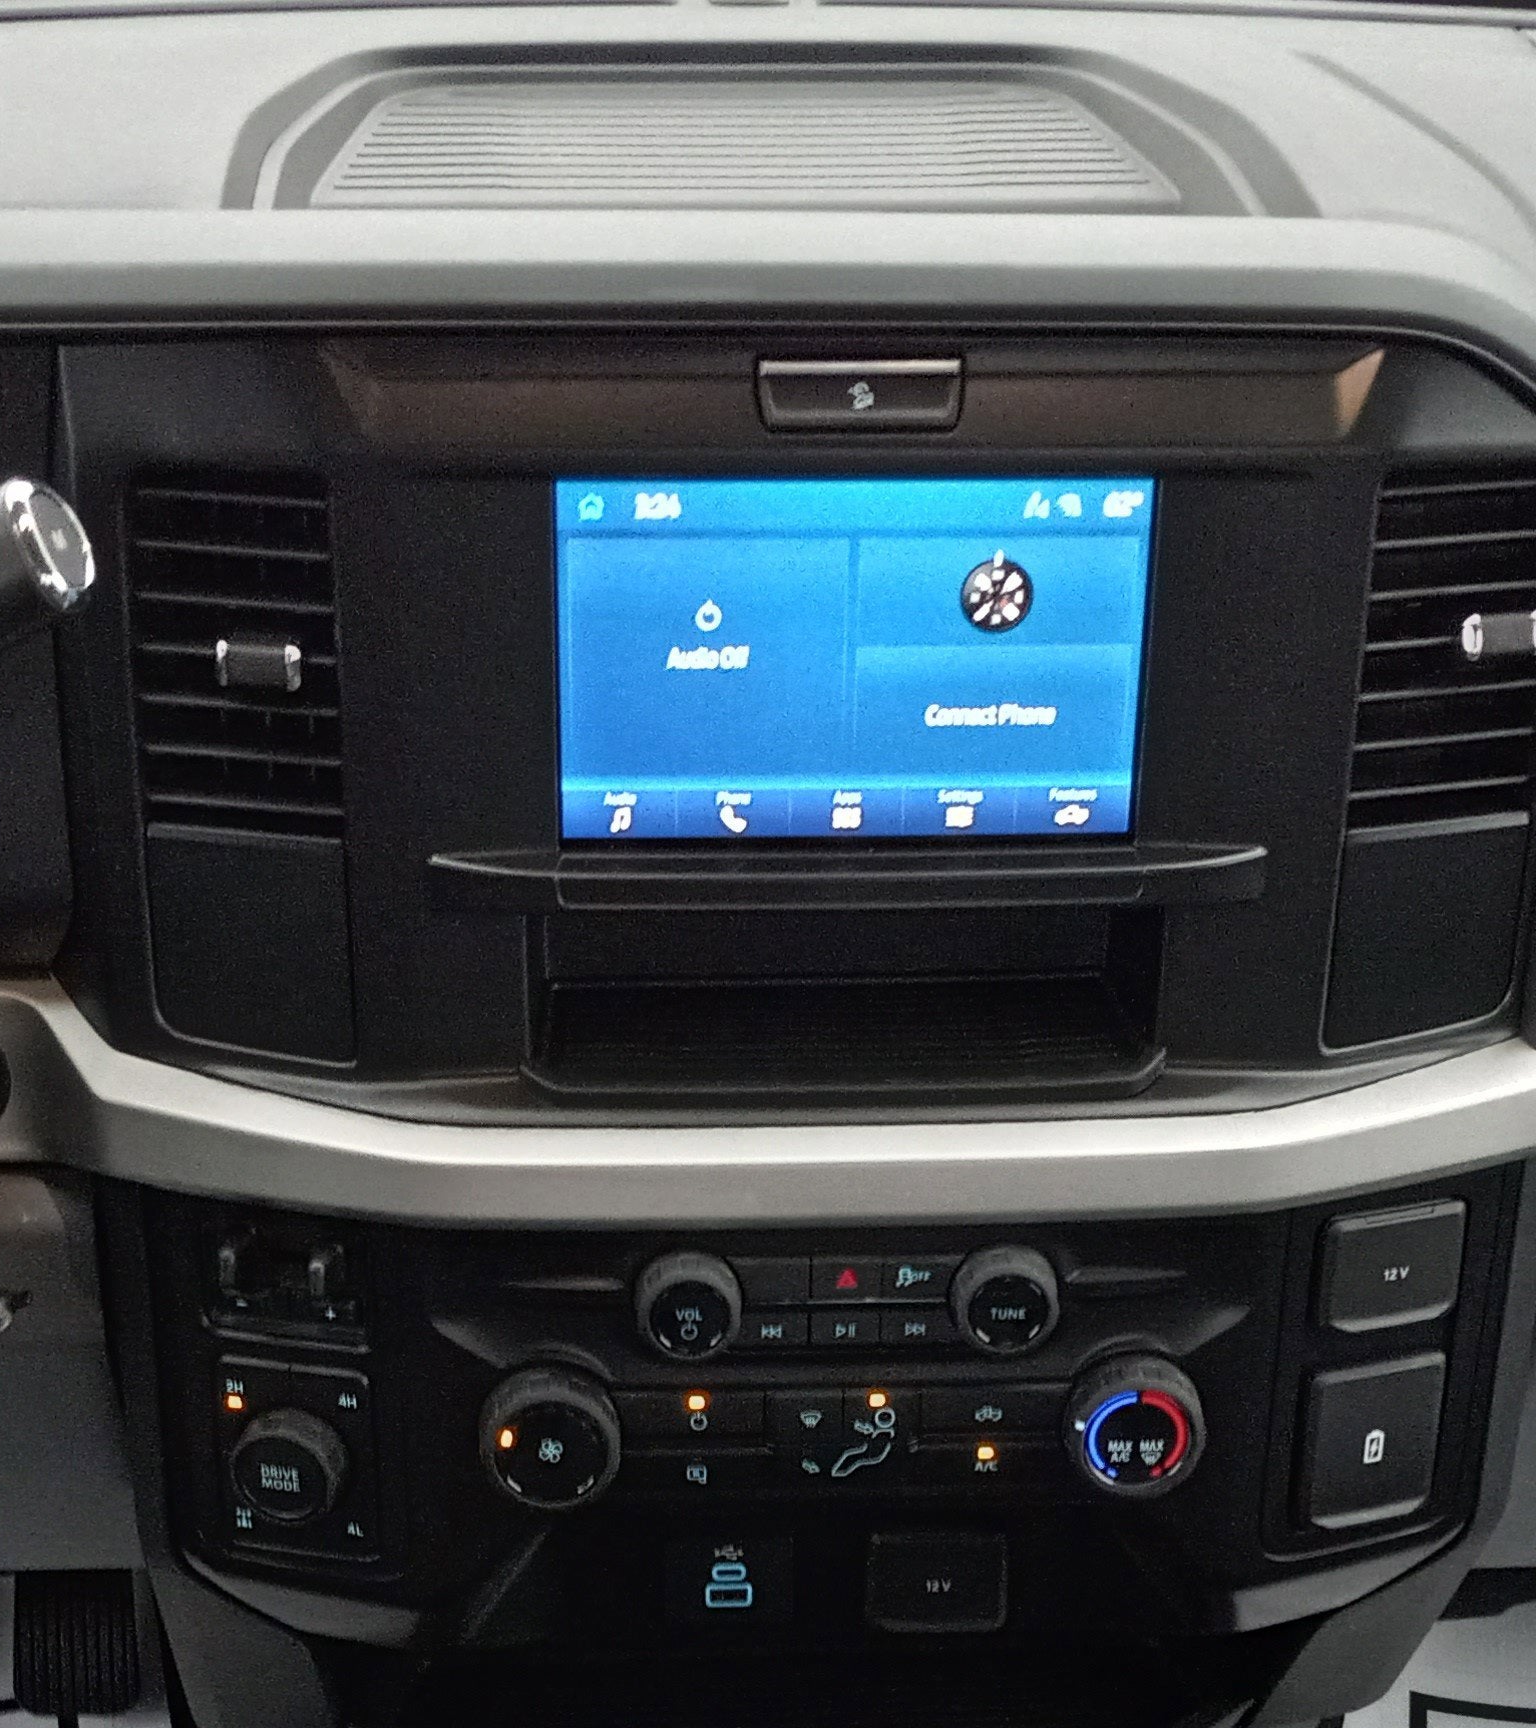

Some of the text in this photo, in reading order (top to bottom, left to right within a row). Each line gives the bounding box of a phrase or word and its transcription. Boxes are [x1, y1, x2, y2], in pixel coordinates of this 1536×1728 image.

[666, 645, 750, 670] Audio Off
[924, 703, 1057, 727] Connect Phone
[675, 1307, 703, 1321] VOL
[990, 1307, 1026, 1320] TUNE
[226, 1378, 243, 1394] 2H
[338, 1392, 357, 1409] 4H
[1107, 1439, 1133, 1452] MAX
[1139, 1438, 1164, 1452] MAX
[260, 1463, 299, 1480] DRIVE
[974, 1461, 998, 1472] A/C
[262, 1478, 301, 1492] MODE
[347, 1521, 364, 1537] 4L
